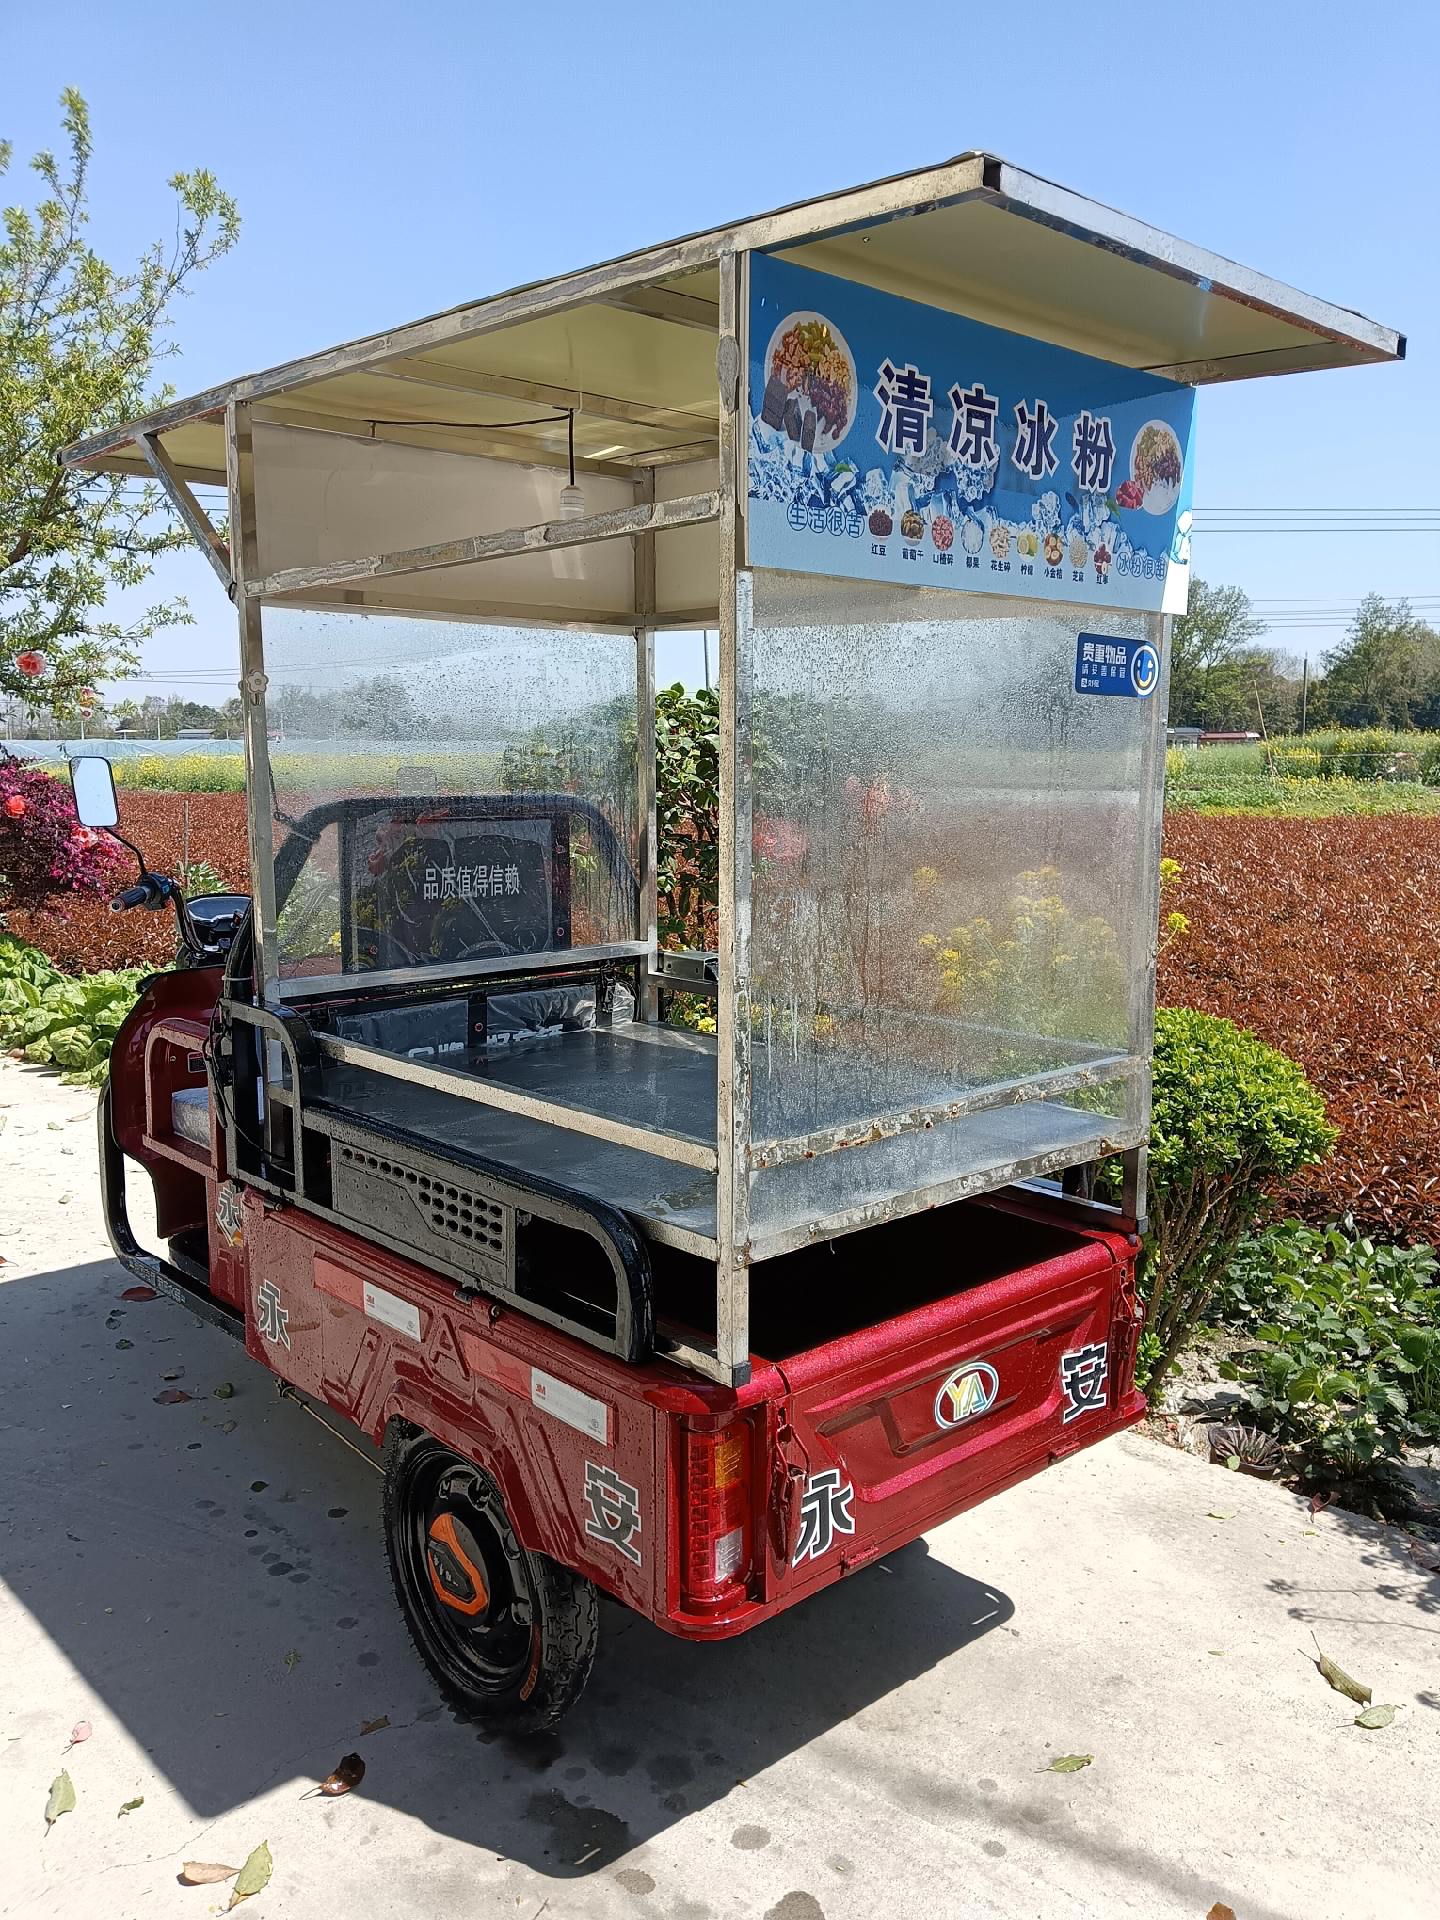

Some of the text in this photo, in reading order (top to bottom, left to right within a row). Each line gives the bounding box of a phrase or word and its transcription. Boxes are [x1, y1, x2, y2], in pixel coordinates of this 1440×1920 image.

[874, 357, 1116, 494] 清凉冰粉
[787, 502, 865, 538] 生活很苦
[871, 543, 887, 556] 红豆
[902, 547, 924, 561] 葡萄干
[990, 560, 1011, 573] 花生碎
[1083, 642, 1126, 664] 贵重物品
[423, 864, 520, 900] 品质值得信赖
[945, 1371, 988, 1421] YA
[257, 1279, 642, 1568] 永 安
[792, 1341, 1108, 1568] 永 安
